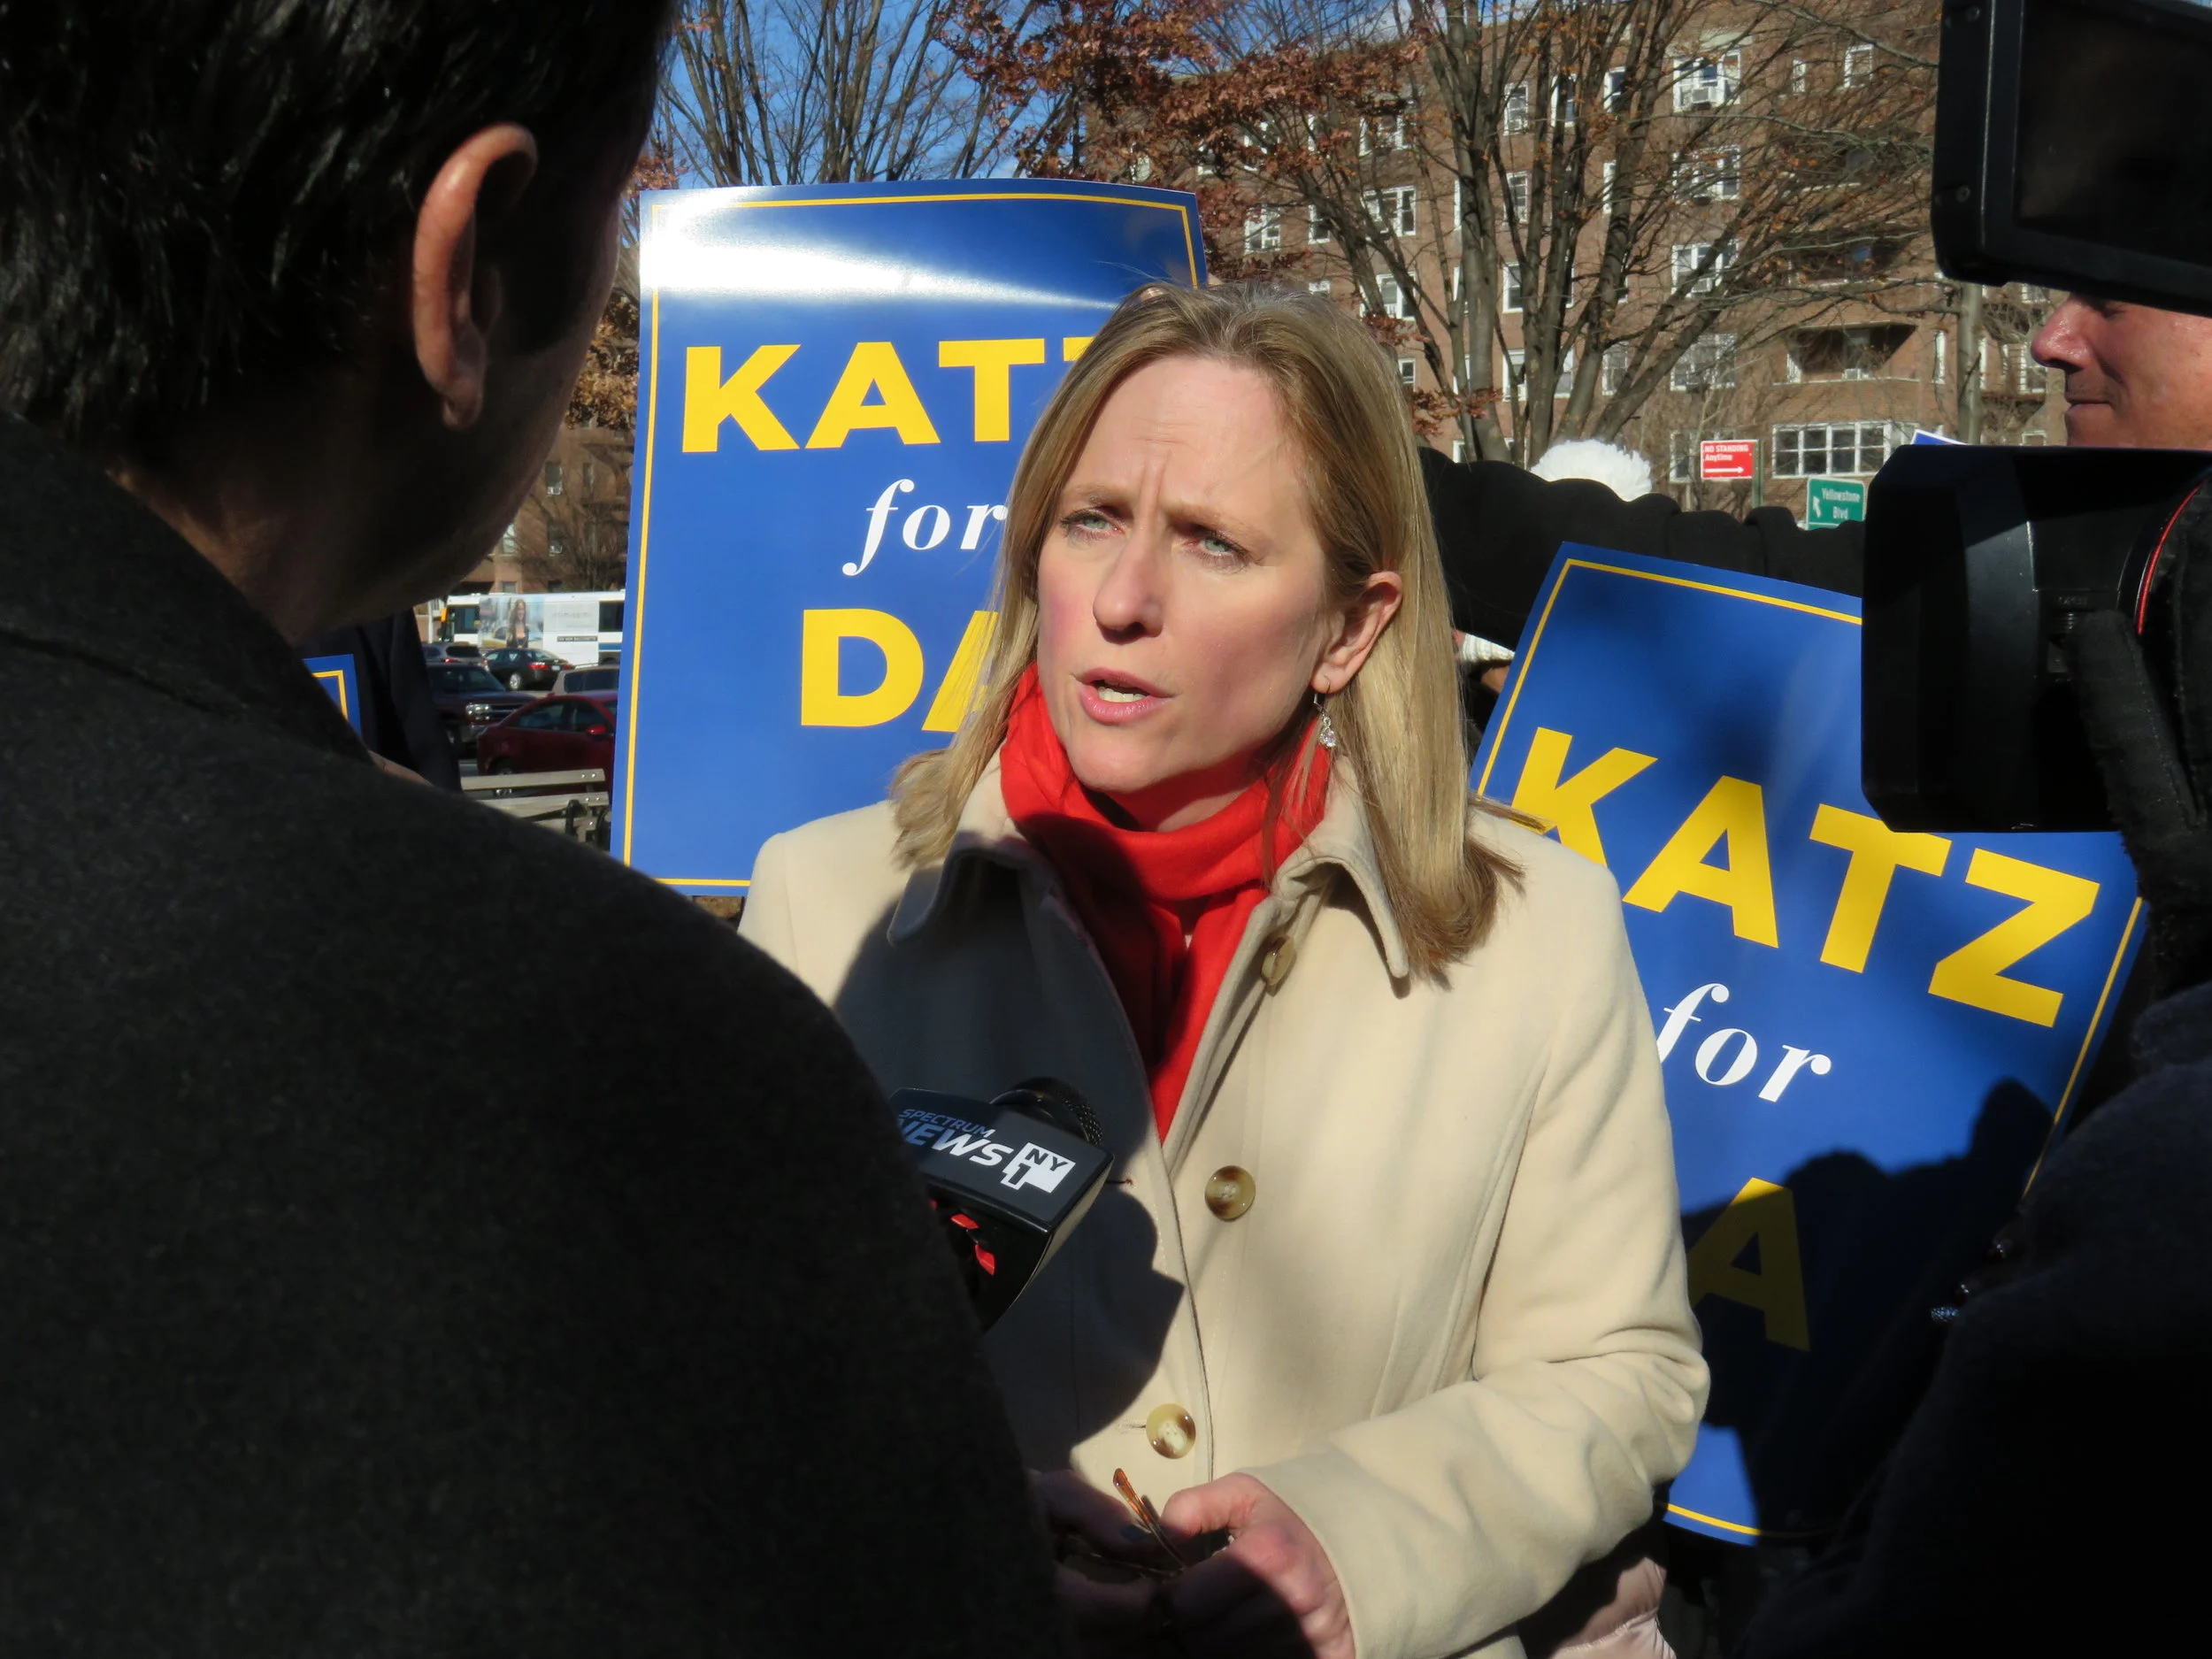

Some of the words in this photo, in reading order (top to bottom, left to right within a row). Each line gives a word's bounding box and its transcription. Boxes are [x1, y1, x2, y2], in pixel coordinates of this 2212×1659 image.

[681, 337, 1096, 453] KAT
[1704, 453, 1733, 462] Anytime
[1822, 488, 1861, 503] Yellowstone
[842, 479, 1009, 576] for
[1832, 505, 1848, 520] Blvd
[1509, 726, 2100, 1027] KATZ
[1656, 983, 1832, 1102] for
[898, 1108, 996, 1139] SPECTRUM
[1687, 1177, 1811, 1353] A
